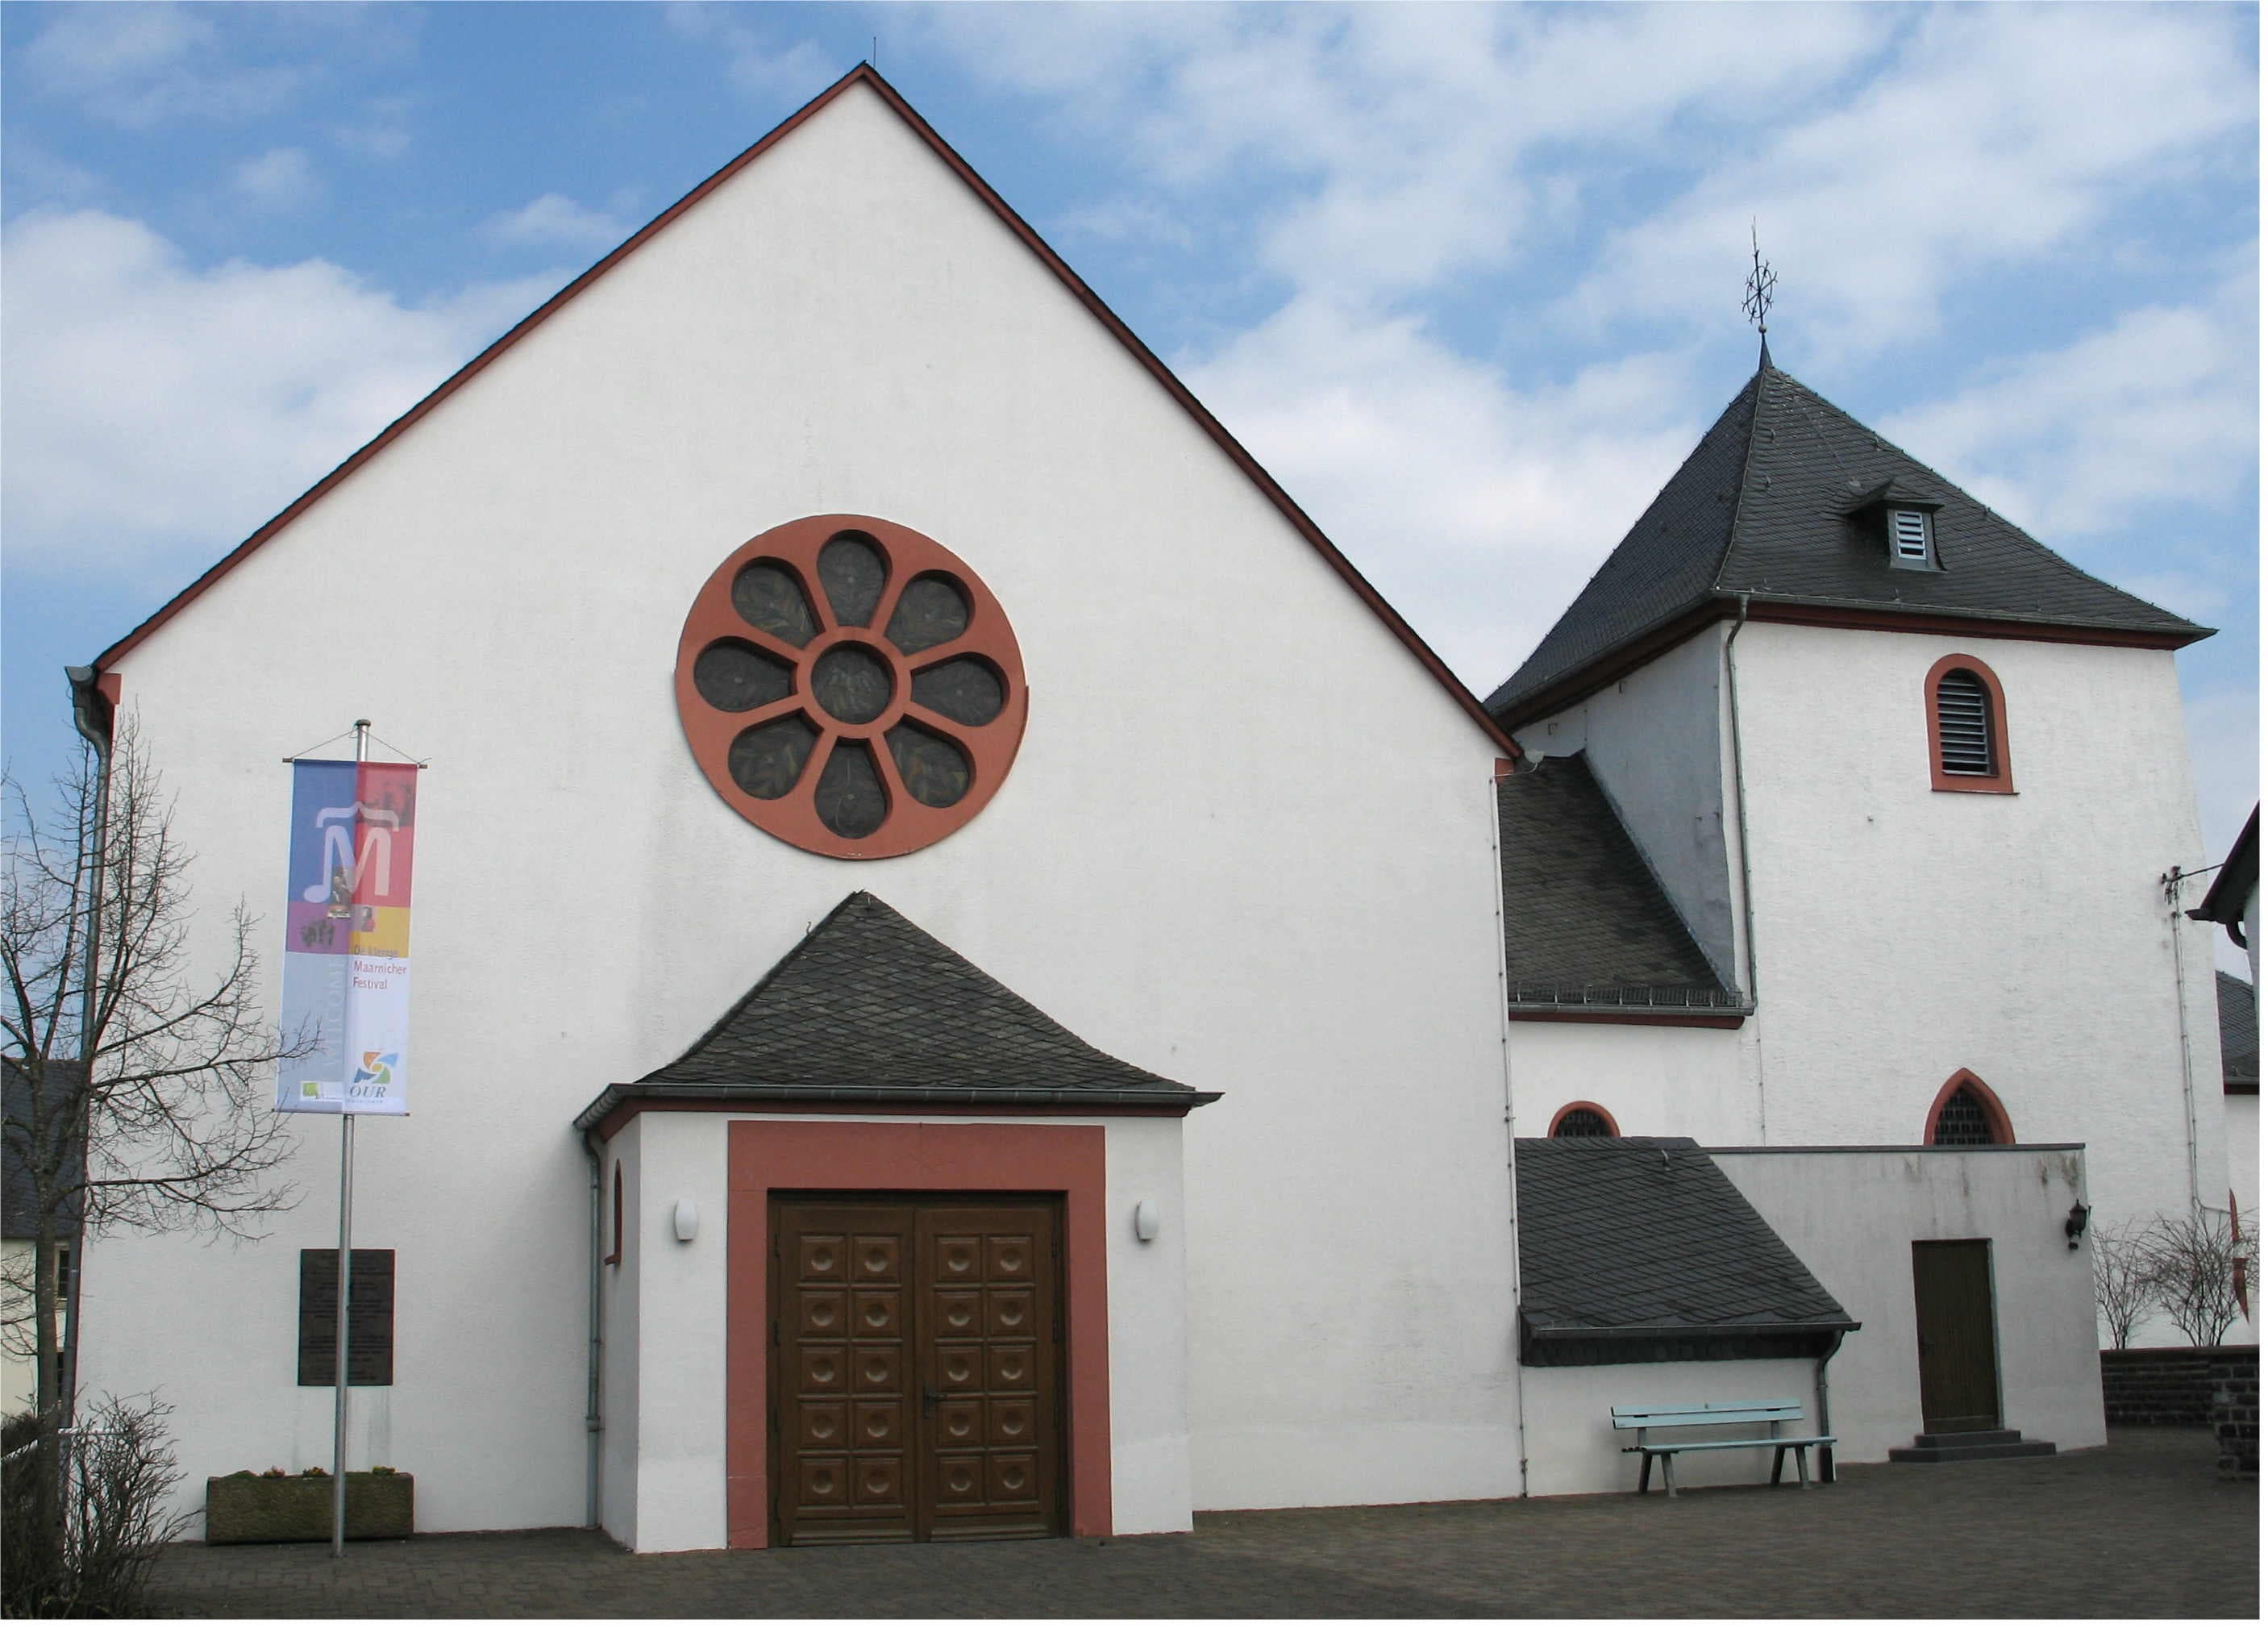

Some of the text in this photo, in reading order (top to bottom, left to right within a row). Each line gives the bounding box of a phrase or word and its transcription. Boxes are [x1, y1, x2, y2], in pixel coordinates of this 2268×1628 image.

[354, 960, 407, 975] Maarnicher
[353, 976, 388, 989] Festival
[349, 1085, 386, 1097] OUR
